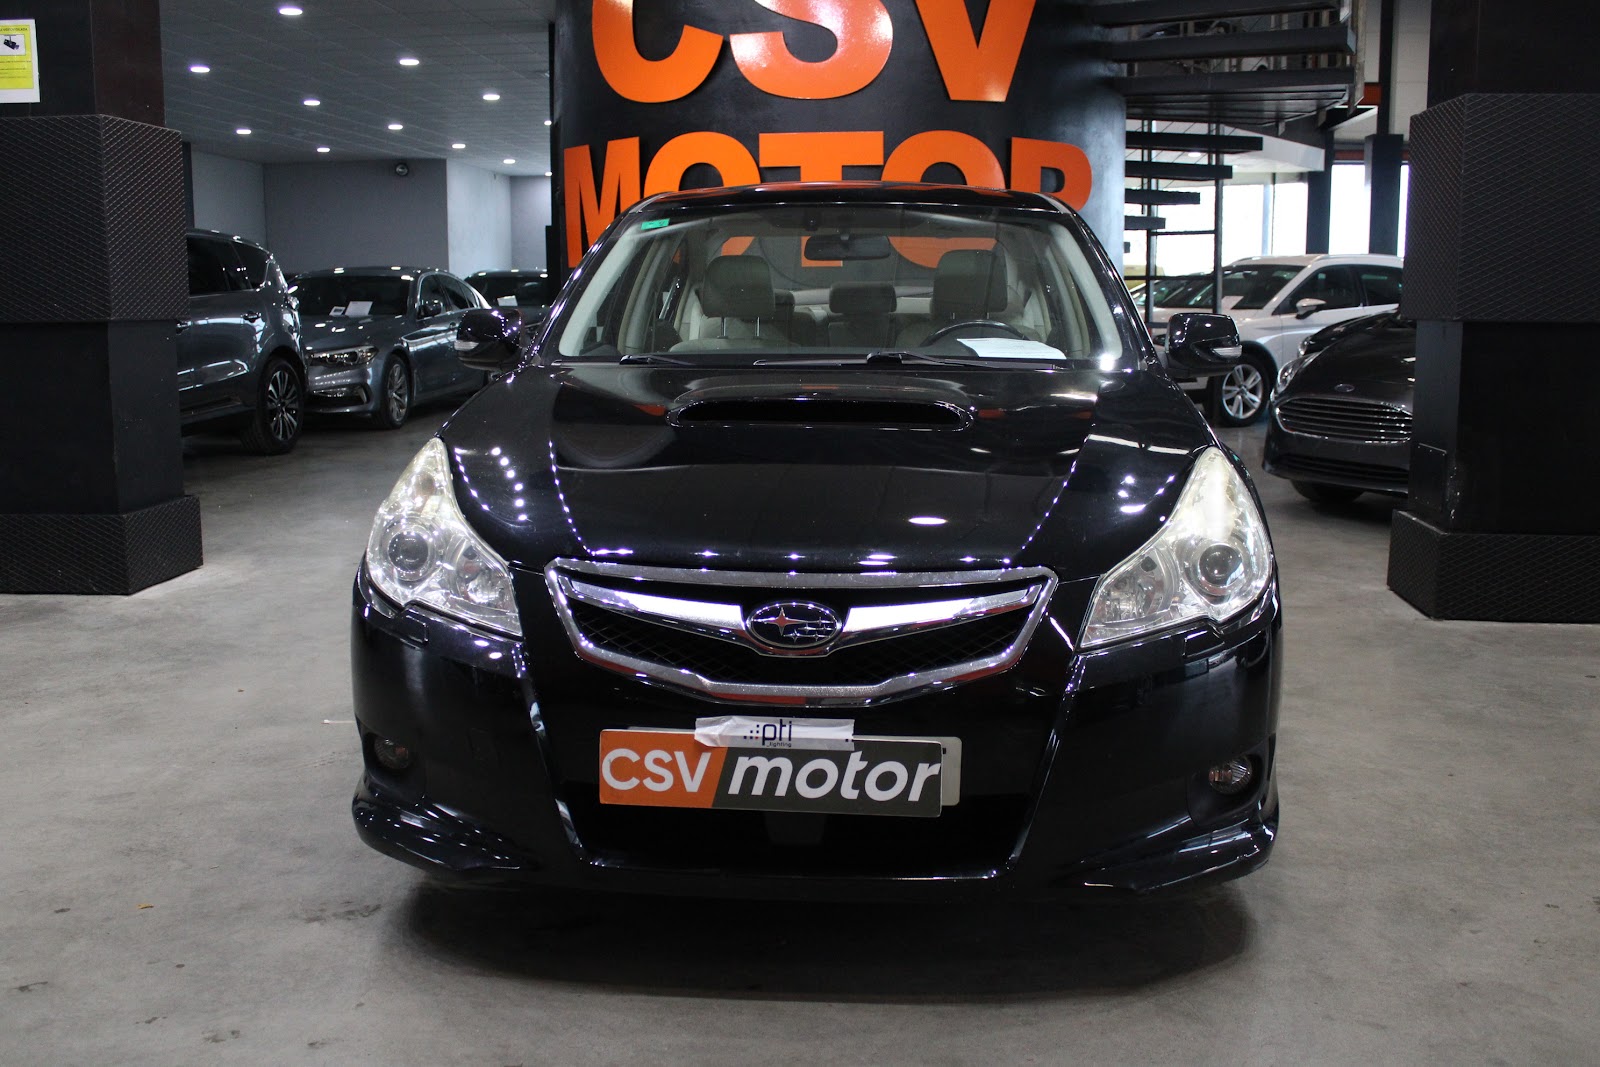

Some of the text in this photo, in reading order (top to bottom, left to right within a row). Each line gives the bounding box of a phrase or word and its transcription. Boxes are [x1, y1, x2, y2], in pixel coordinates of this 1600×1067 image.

[762, 719, 792, 746] pti
[601, 748, 941, 802] CSV motor
